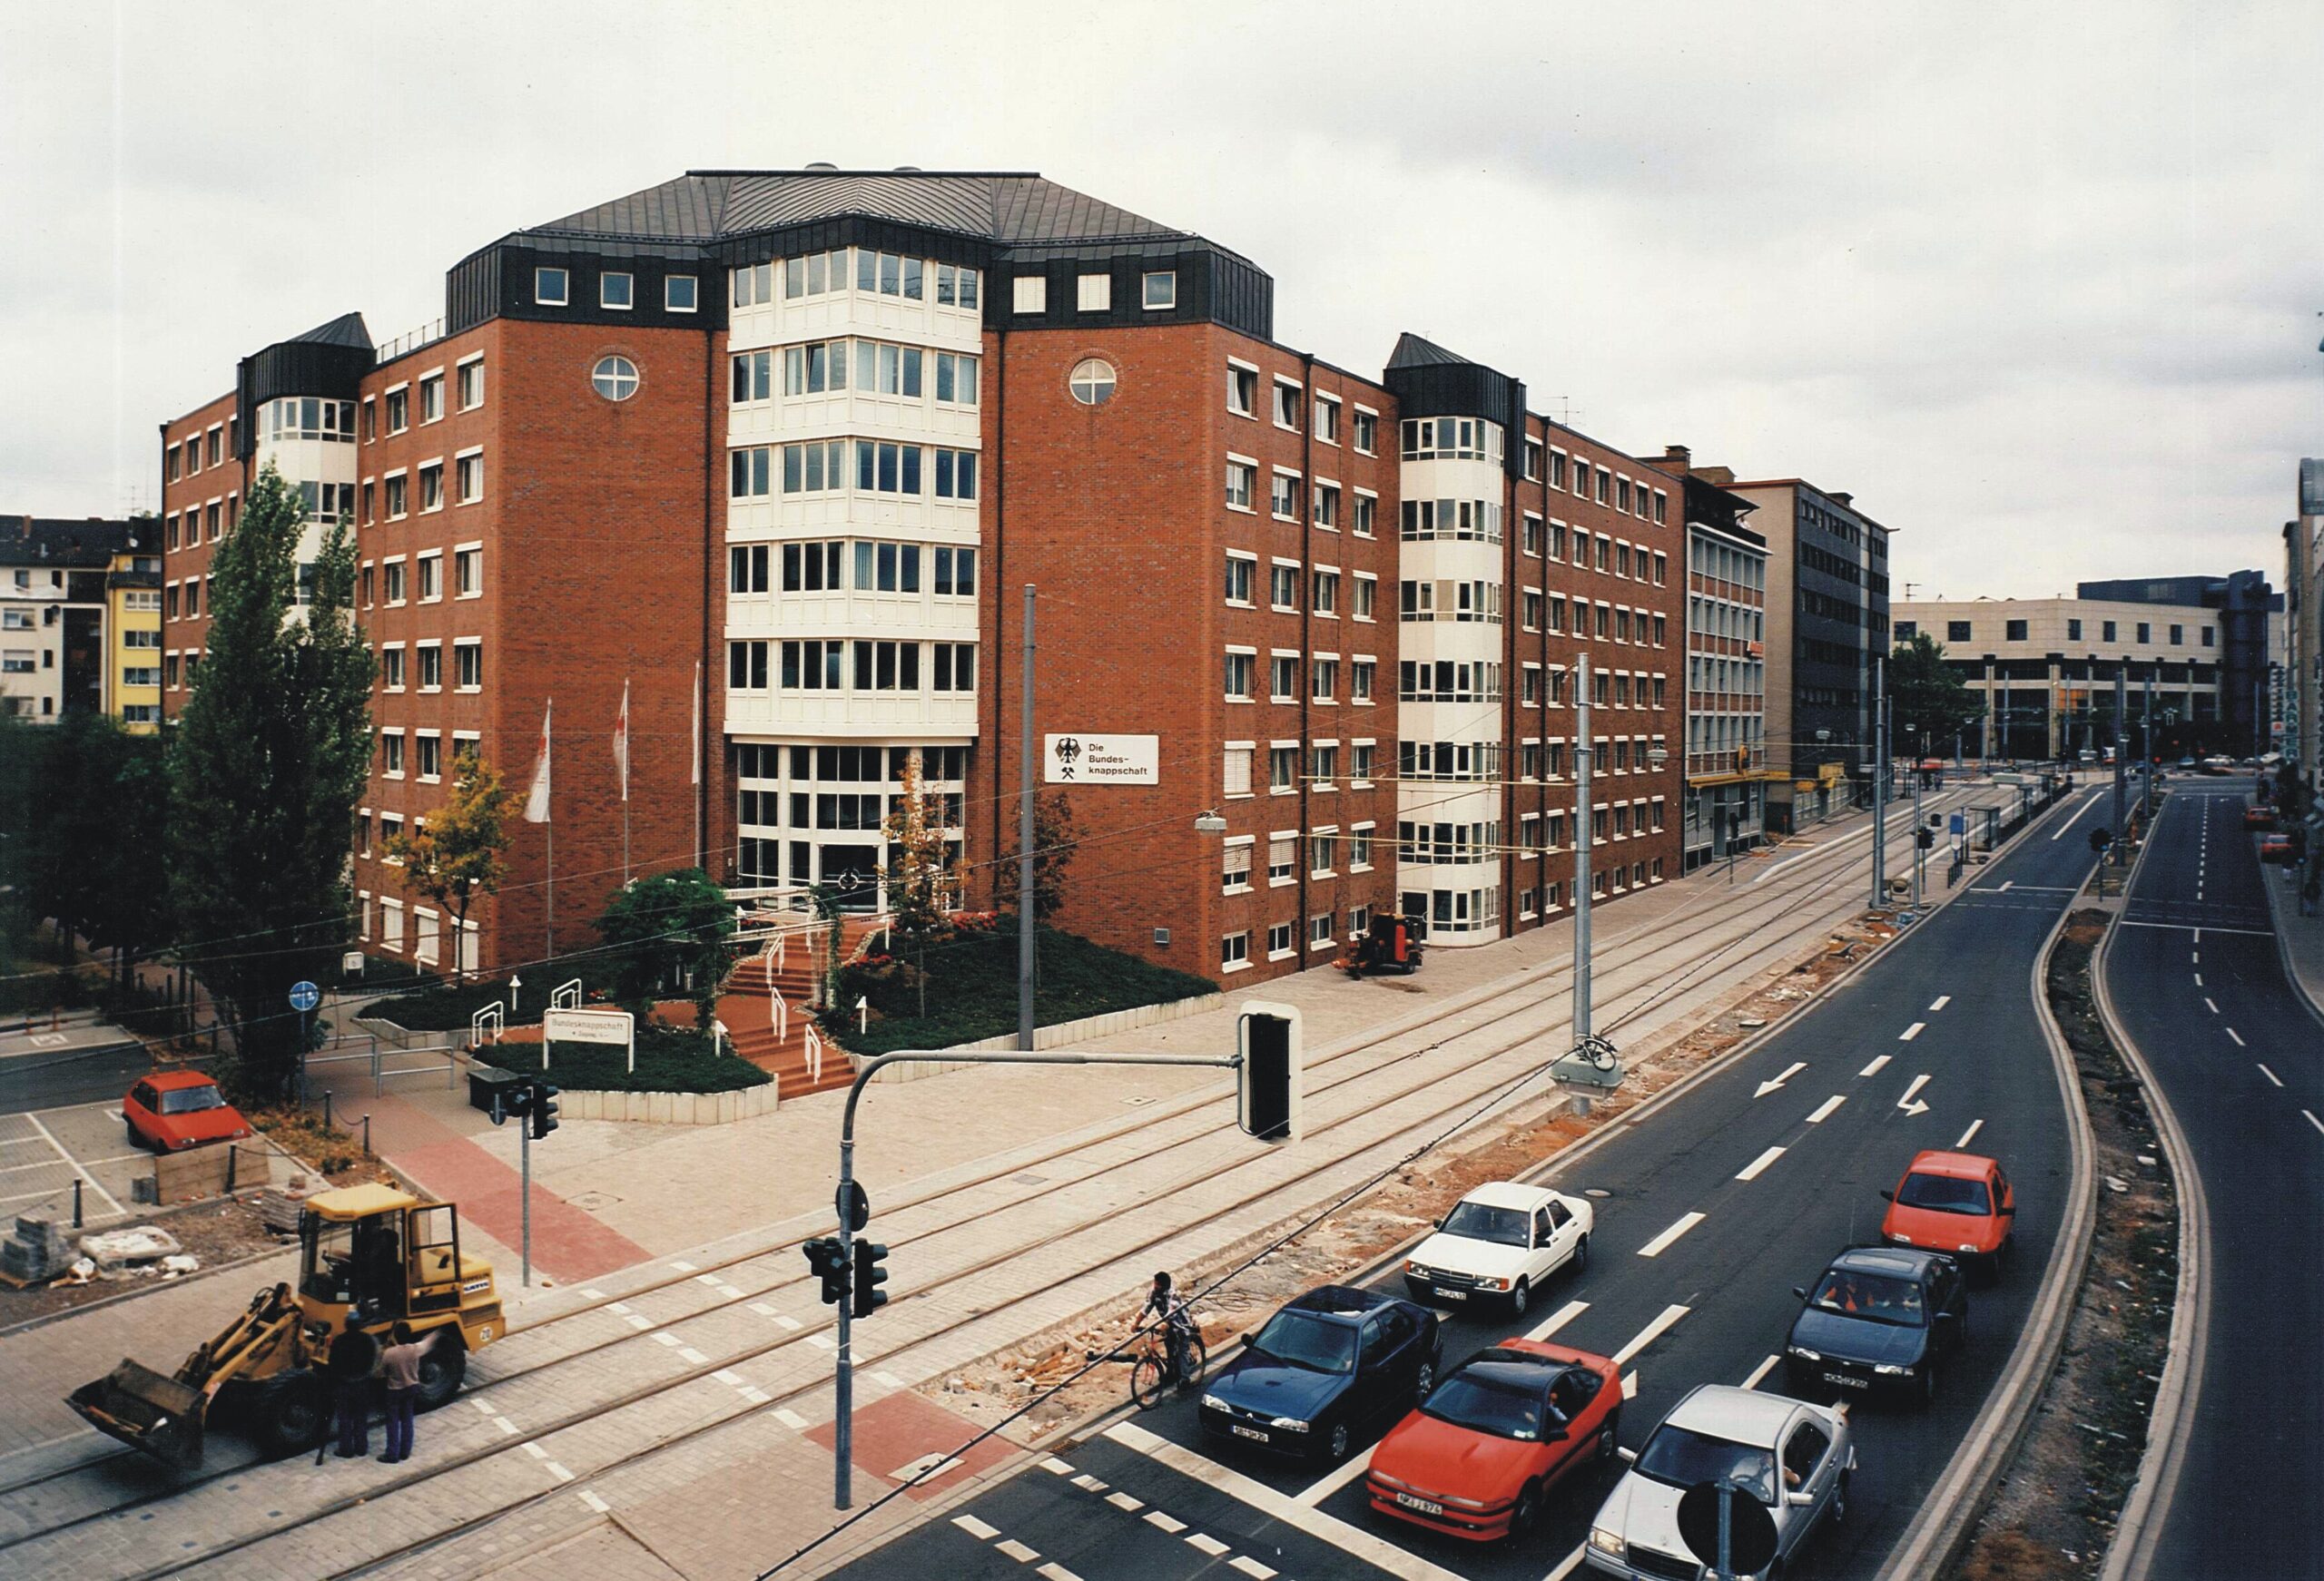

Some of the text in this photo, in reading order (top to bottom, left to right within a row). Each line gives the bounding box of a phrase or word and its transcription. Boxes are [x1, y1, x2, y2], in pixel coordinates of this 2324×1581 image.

[1088, 743, 1104, 751] Die
[1088, 755, 1129, 763] Bundes-
[1088, 767, 1147, 776] knappschaft
[551, 1018, 623, 1030] Bundesknappschaft
